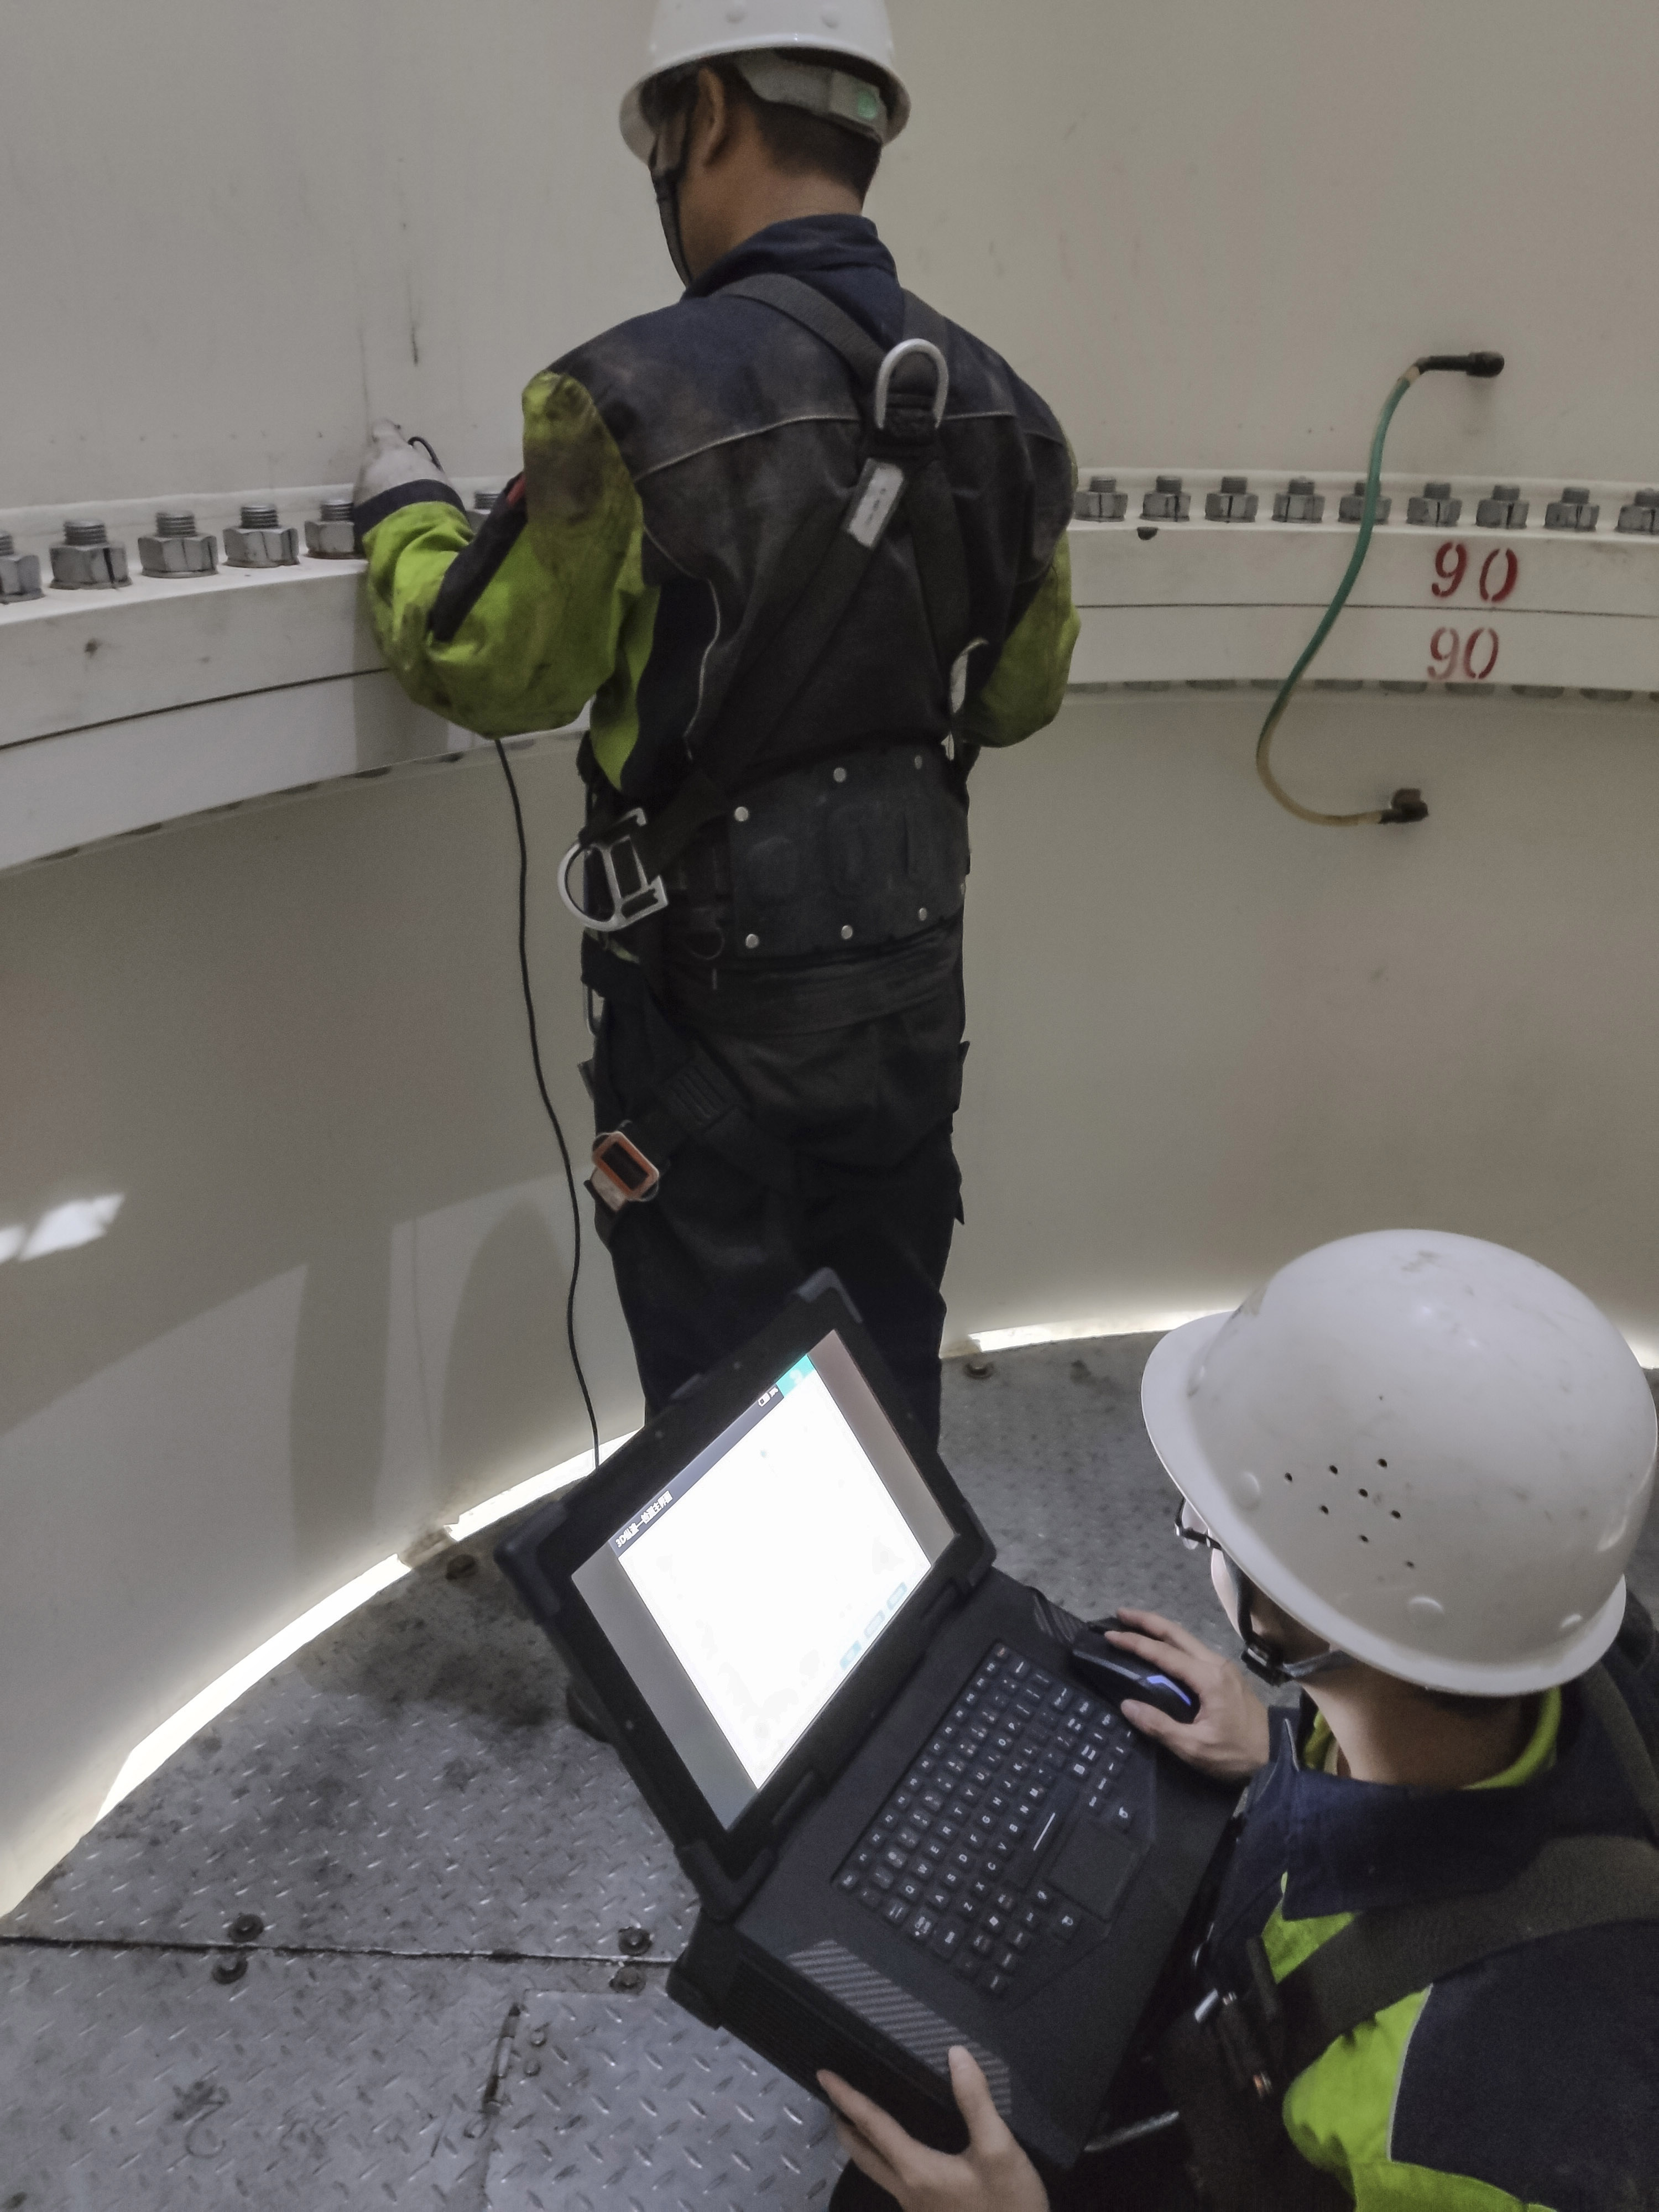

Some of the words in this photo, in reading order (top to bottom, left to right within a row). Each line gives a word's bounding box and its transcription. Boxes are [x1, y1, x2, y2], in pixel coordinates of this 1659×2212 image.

[1431, 541, 1518, 602] 90
[1427, 627, 1499, 680] 90
[1008, 1722, 1015, 1730] P
[976, 1772, 985, 1780] U
[1029, 1788, 1039, 1797] M
[993, 1797, 1002, 1806] H
[1020, 1804, 1029, 1814] N
[982, 1815, 990, 1824] G
[942, 1826, 951, 1835] R
[1009, 1823, 1018, 1833] B
[969, 1834, 978, 1842] F
[930, 1845, 939, 1854] E
[958, 1854, 968, 1863] D
[917, 1864, 928, 1874] W
[987, 1862, 996, 1870] C
[947, 1873, 956, 1882] S
[905, 1885, 915, 1894] Q
[975, 1881, 985, 1891] X
[935, 1895, 945, 1903] A
[963, 1902, 973, 1911] Z
